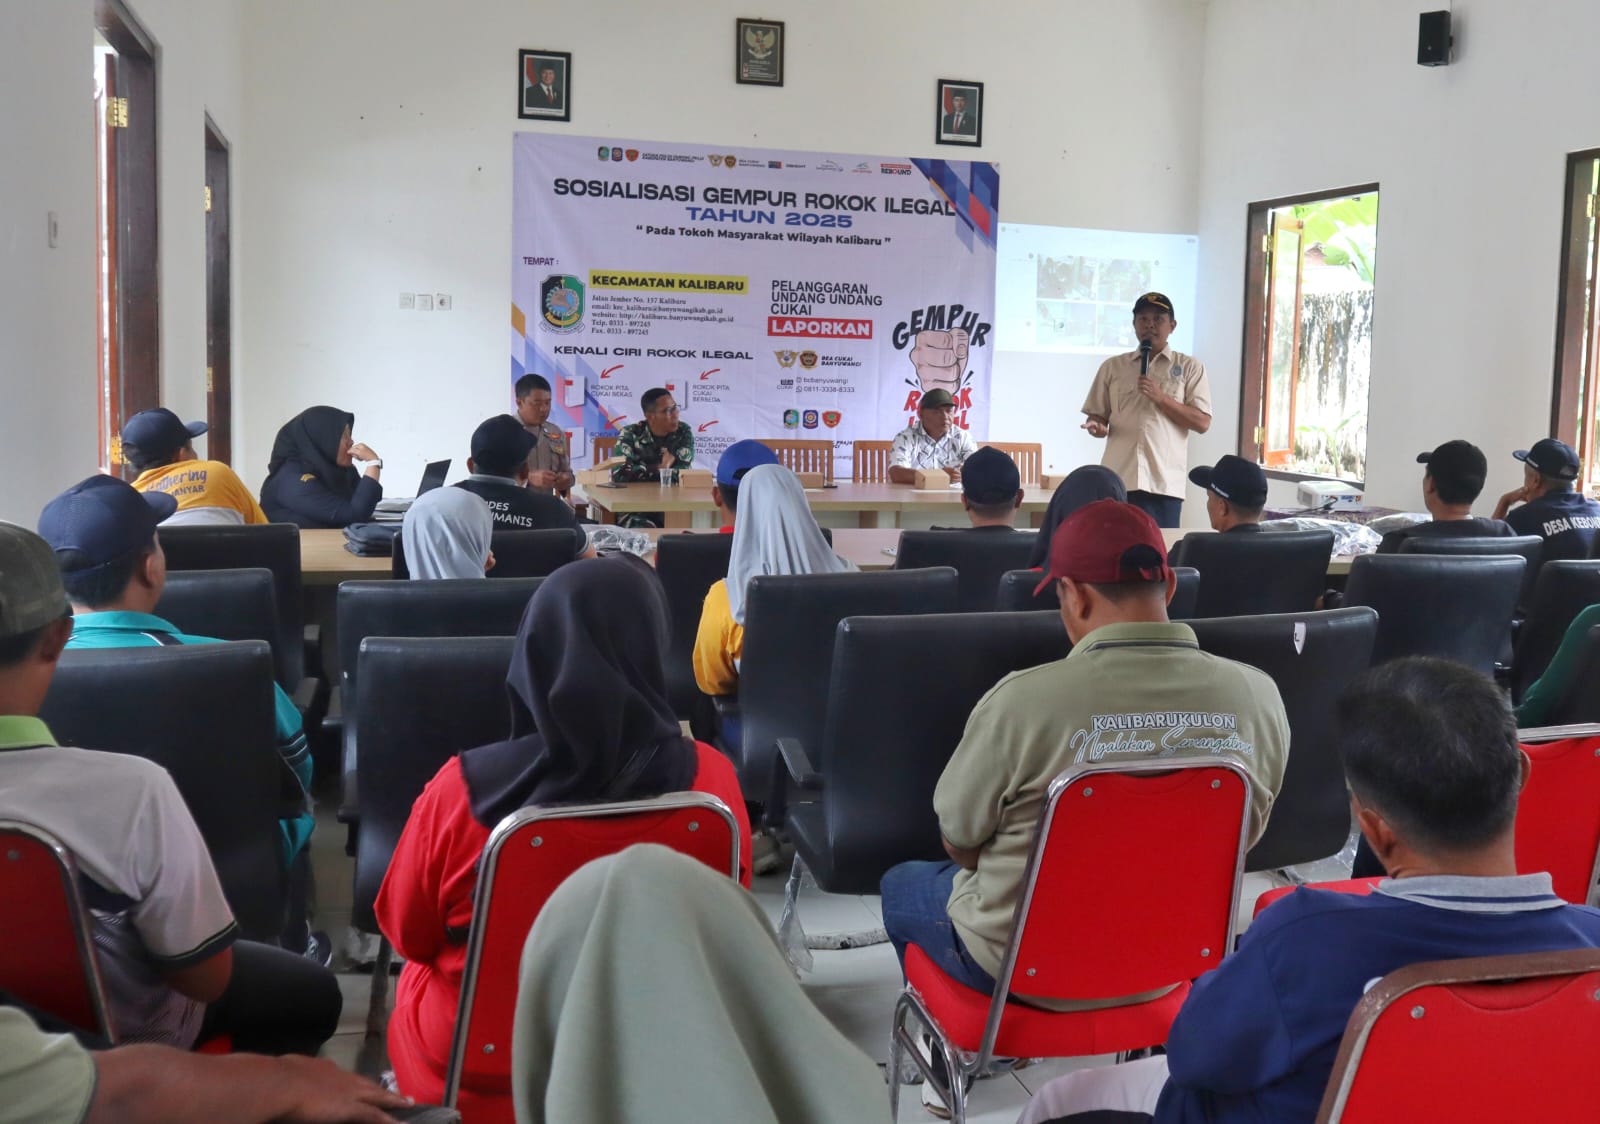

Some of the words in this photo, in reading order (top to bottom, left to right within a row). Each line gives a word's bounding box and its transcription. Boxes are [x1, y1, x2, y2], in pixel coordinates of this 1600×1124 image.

[553, 178, 696, 203] SOSIALISASI
[703, 186, 797, 208] GEMPUR
[805, 192, 877, 213] ROKOK
[885, 197, 956, 217] ILEGAL
[685, 207, 776, 225] TAHUN
[785, 212, 853, 229] 2025
[646, 226, 675, 237] Pada
[679, 227, 714, 239] Tokoh
[717, 229, 784, 244] Masyarakat
[787, 231, 833, 246] Wilayah
[835, 234, 882, 246] Kalibaru
[593, 275, 675, 289] KECAMATAN
[678, 279, 744, 291] KALIBARU
[771, 280, 868, 294] PELANGGARAN
[771, 292, 825, 304] UNDANG
[829, 295, 883, 306] UNDANG
[771, 304, 812, 316] CUKAI
[771, 320, 870, 337] LAPORKAN
[892, 303, 992, 350] GEMPUR
[554, 345, 607, 356] KENALI
[613, 347, 641, 357] CIRI
[647, 348, 696, 358] ROKOK
[702, 350, 754, 360] ILEGAL
[485, 501, 509, 511] DES
[1543, 518, 1571, 536] DESA
[1091, 712, 1237, 731] KALIBARUKULON
[1070, 728, 1156, 765] Nyalakan
